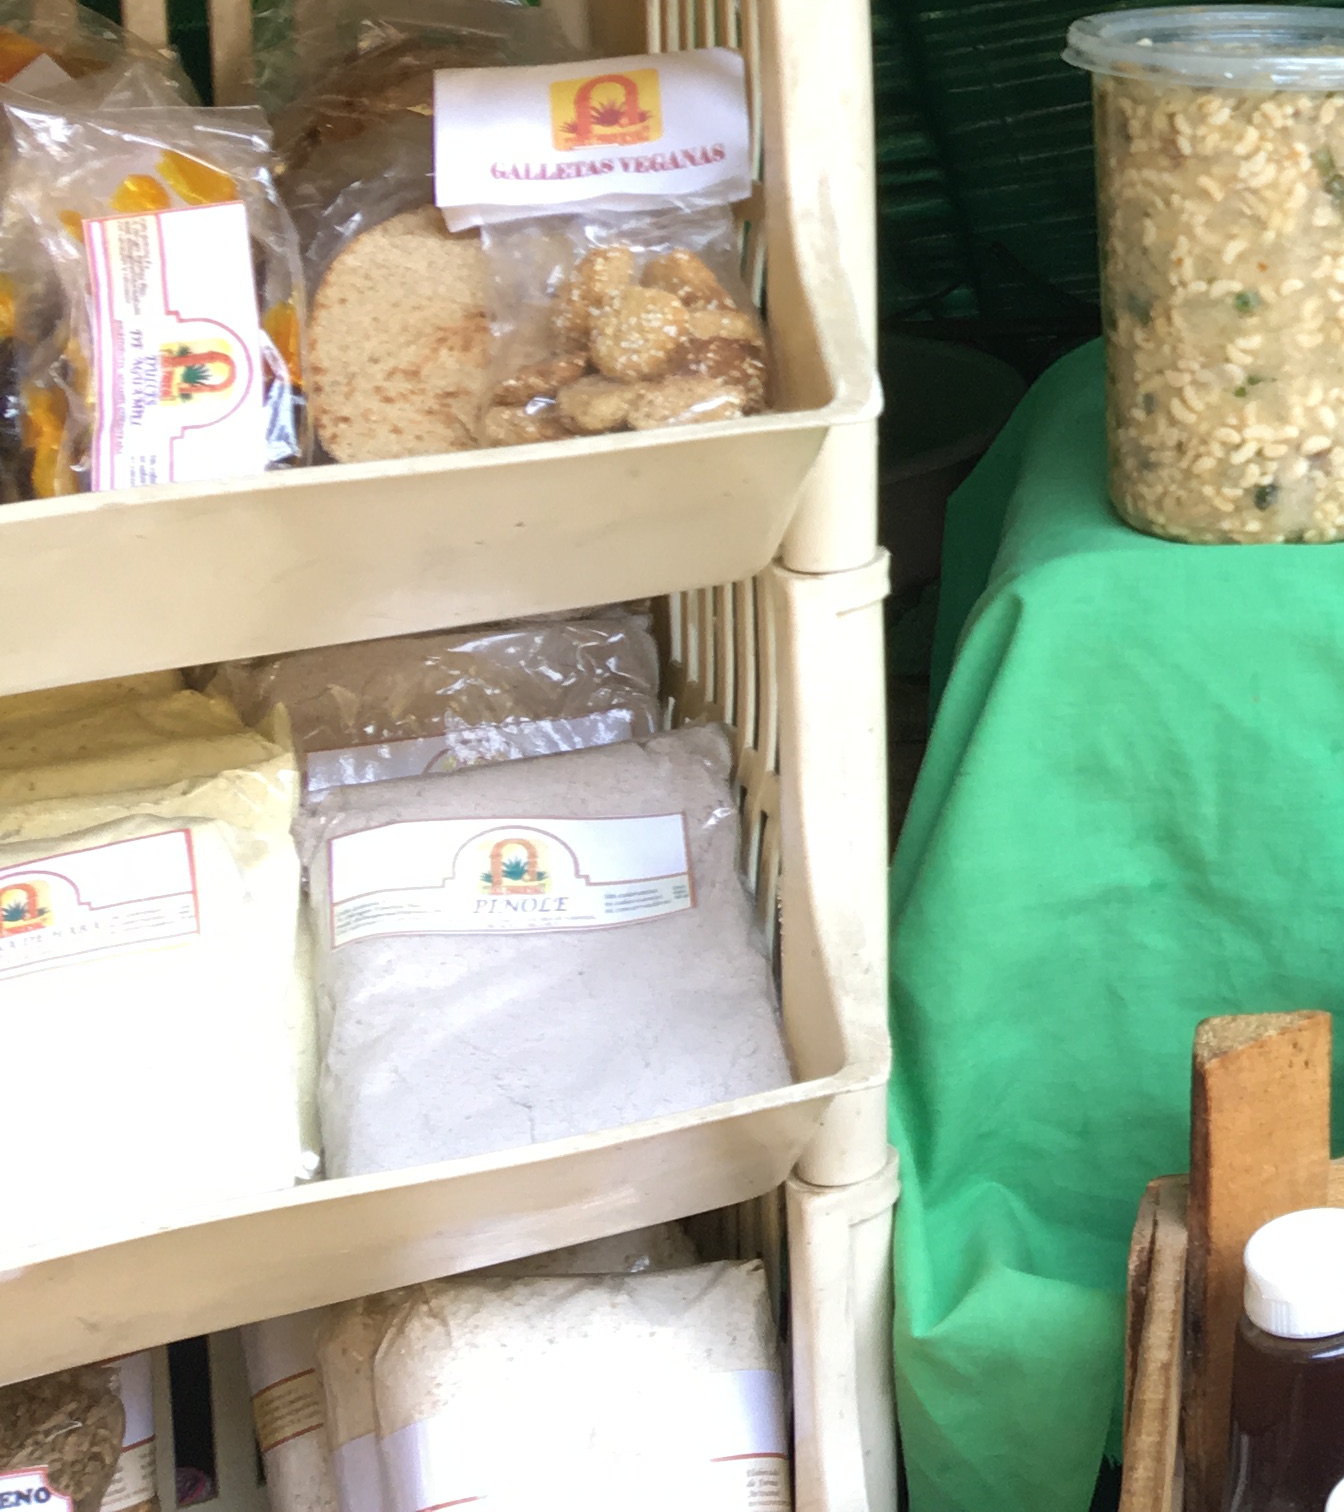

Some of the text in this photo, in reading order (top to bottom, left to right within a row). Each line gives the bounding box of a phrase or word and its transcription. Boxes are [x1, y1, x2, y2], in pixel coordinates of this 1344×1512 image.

[490, 143, 726, 181] GALLETAS VEGANAS
[473, 896, 569, 914] PINOLE
[0, 1486, 51, 1510] ENO
